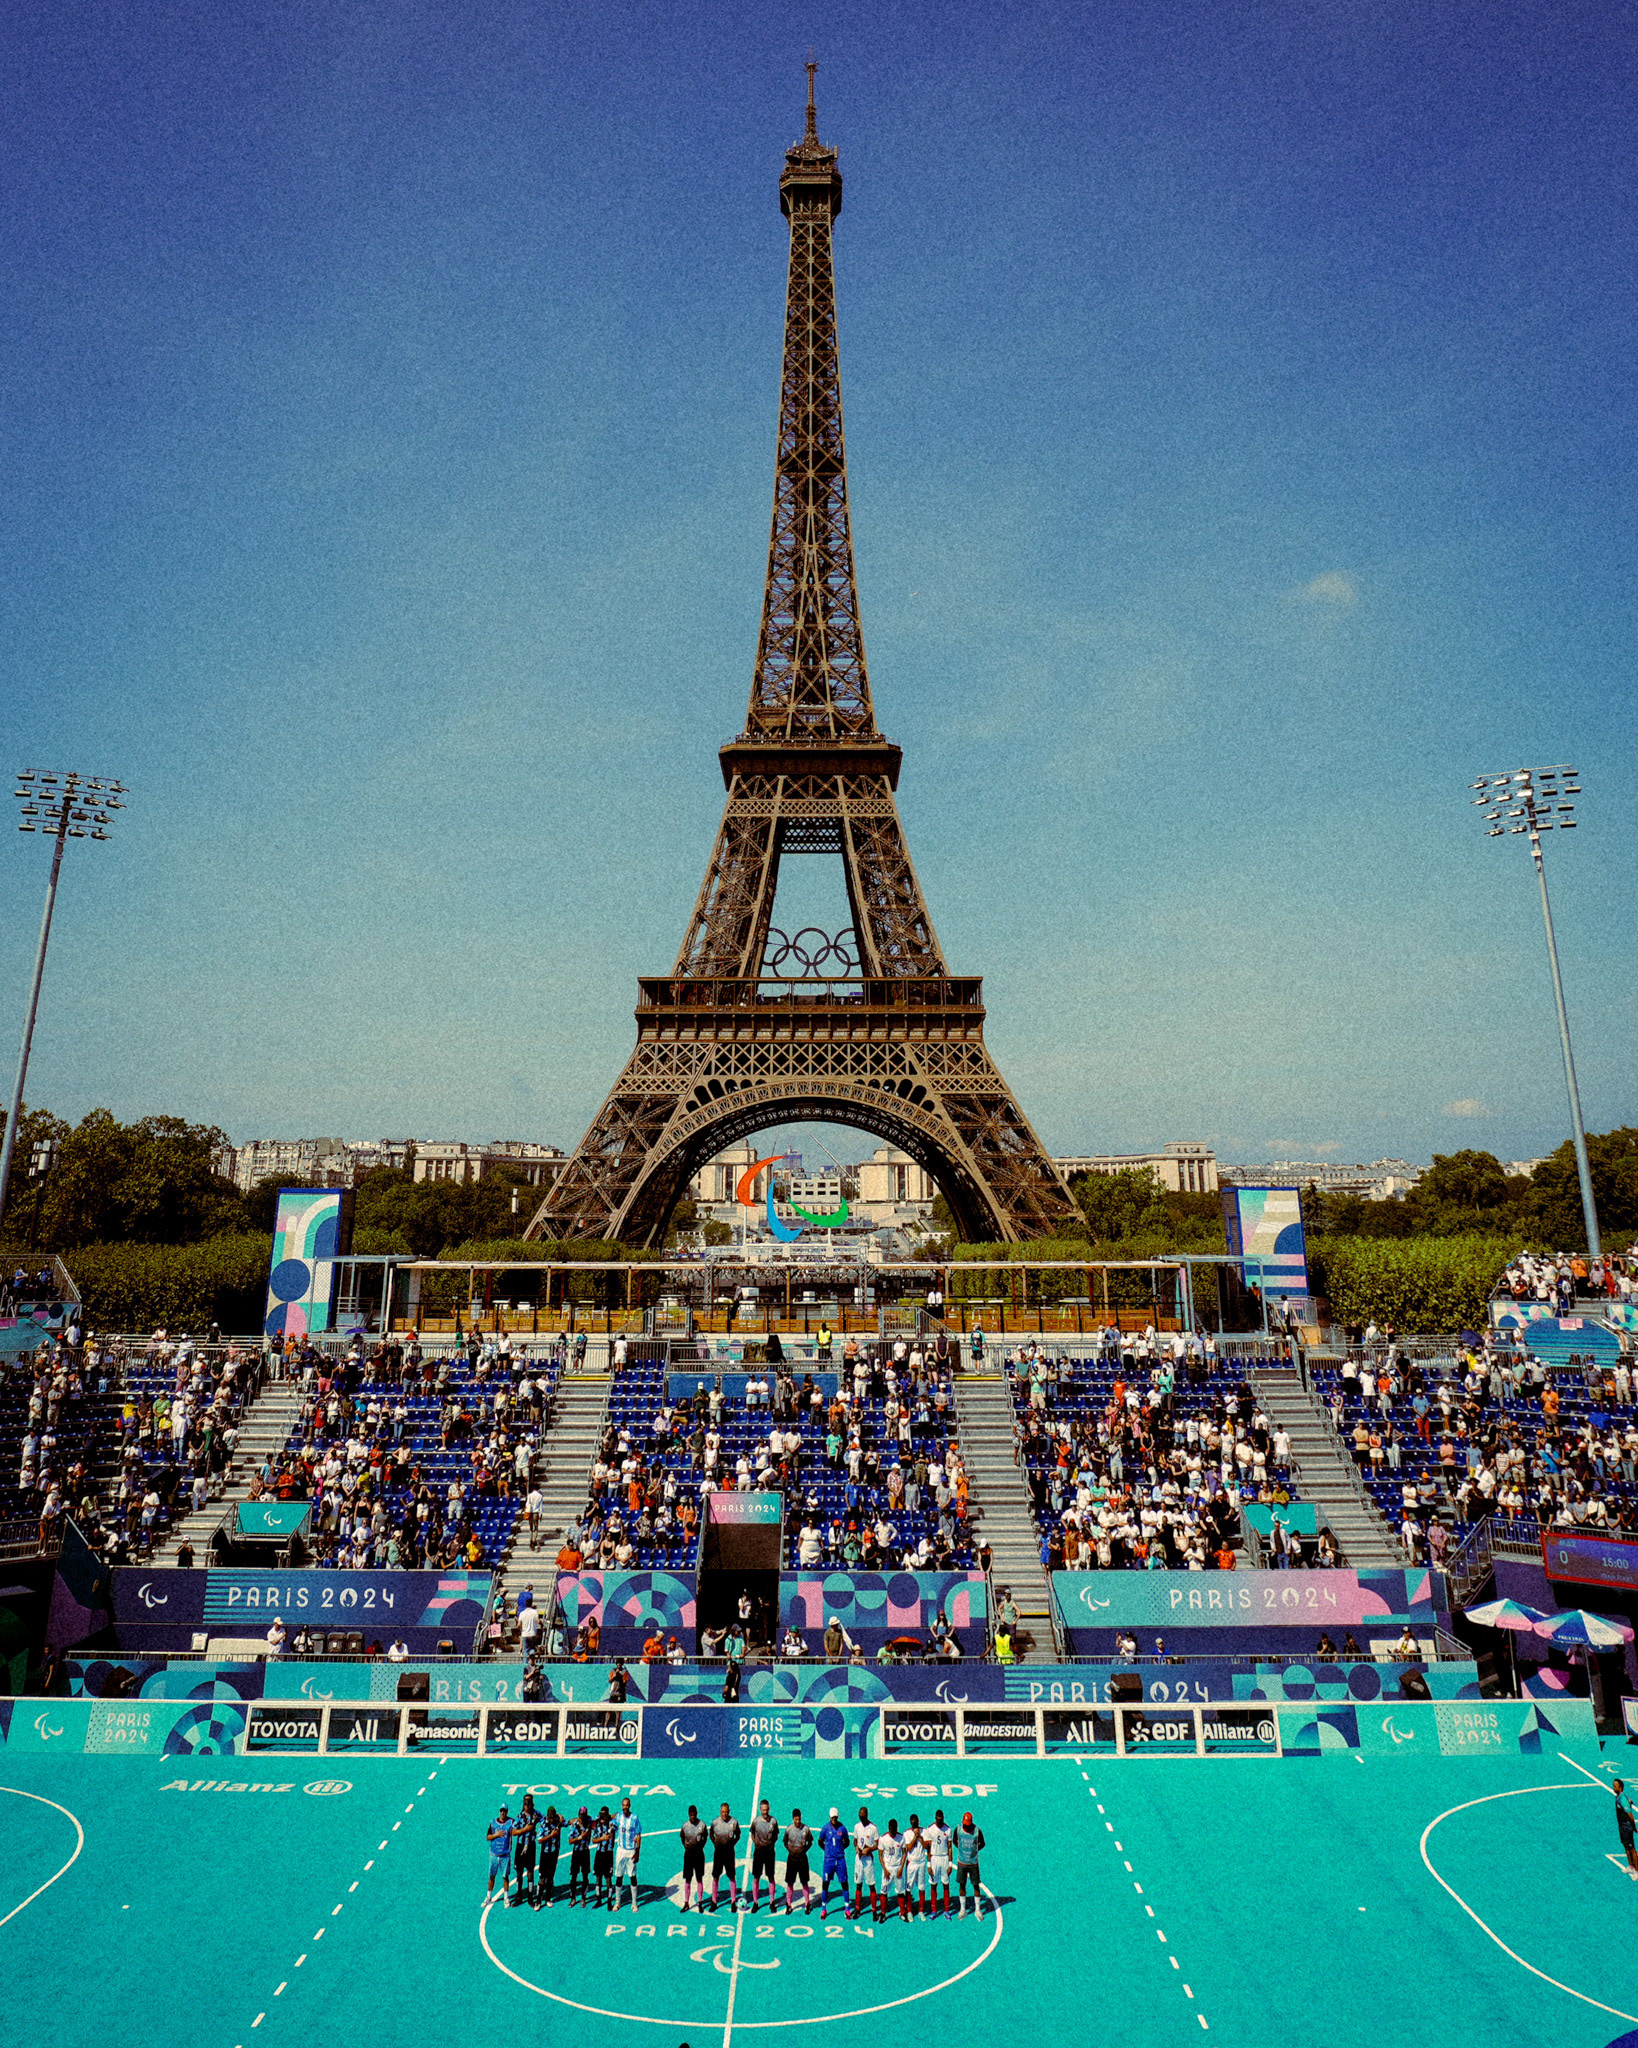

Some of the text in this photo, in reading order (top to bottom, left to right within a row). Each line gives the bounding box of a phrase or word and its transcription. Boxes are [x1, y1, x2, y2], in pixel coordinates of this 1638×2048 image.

[748, 1504, 776, 1513] 2024
[1560, 1550, 1568, 1564] 0
[1602, 1557, 1630, 1570] 15:00
[321, 1588, 394, 1608] 2024
[1263, 1587, 1337, 1607] 2024
[1150, 1681, 1209, 1702] 024
[104, 1729, 148, 1743] 2024
[251, 1721, 318, 1738] TOYOTA
[407, 1723, 479, 1739] Panasonic
[565, 1723, 617, 1740] Allianz
[886, 1725, 955, 1741] TOYOTA
[1203, 1723, 1255, 1740] Allianz
[1456, 1730, 1502, 1744] 2024
[739, 1733, 783, 1748] 2024
[158, 1780, 296, 1792] Allianz
[501, 1784, 676, 1796] TOYOTA
[755, 1925, 875, 1938] 2024
